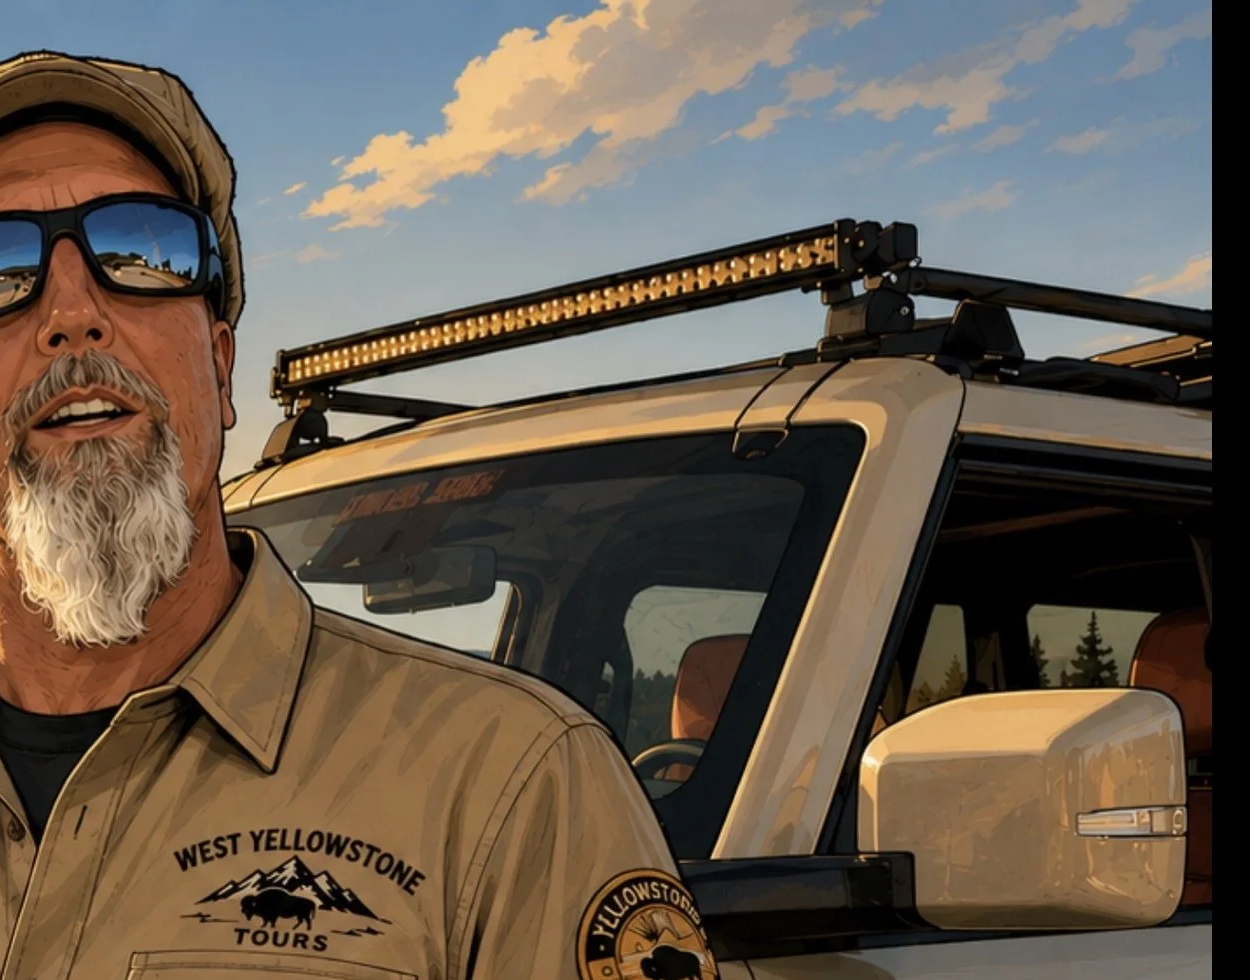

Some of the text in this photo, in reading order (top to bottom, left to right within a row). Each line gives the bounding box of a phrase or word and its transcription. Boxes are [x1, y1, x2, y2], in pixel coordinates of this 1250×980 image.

[173, 828, 427, 897] WEST YELLOWSTONE
[234, 928, 329, 952] TOURS
